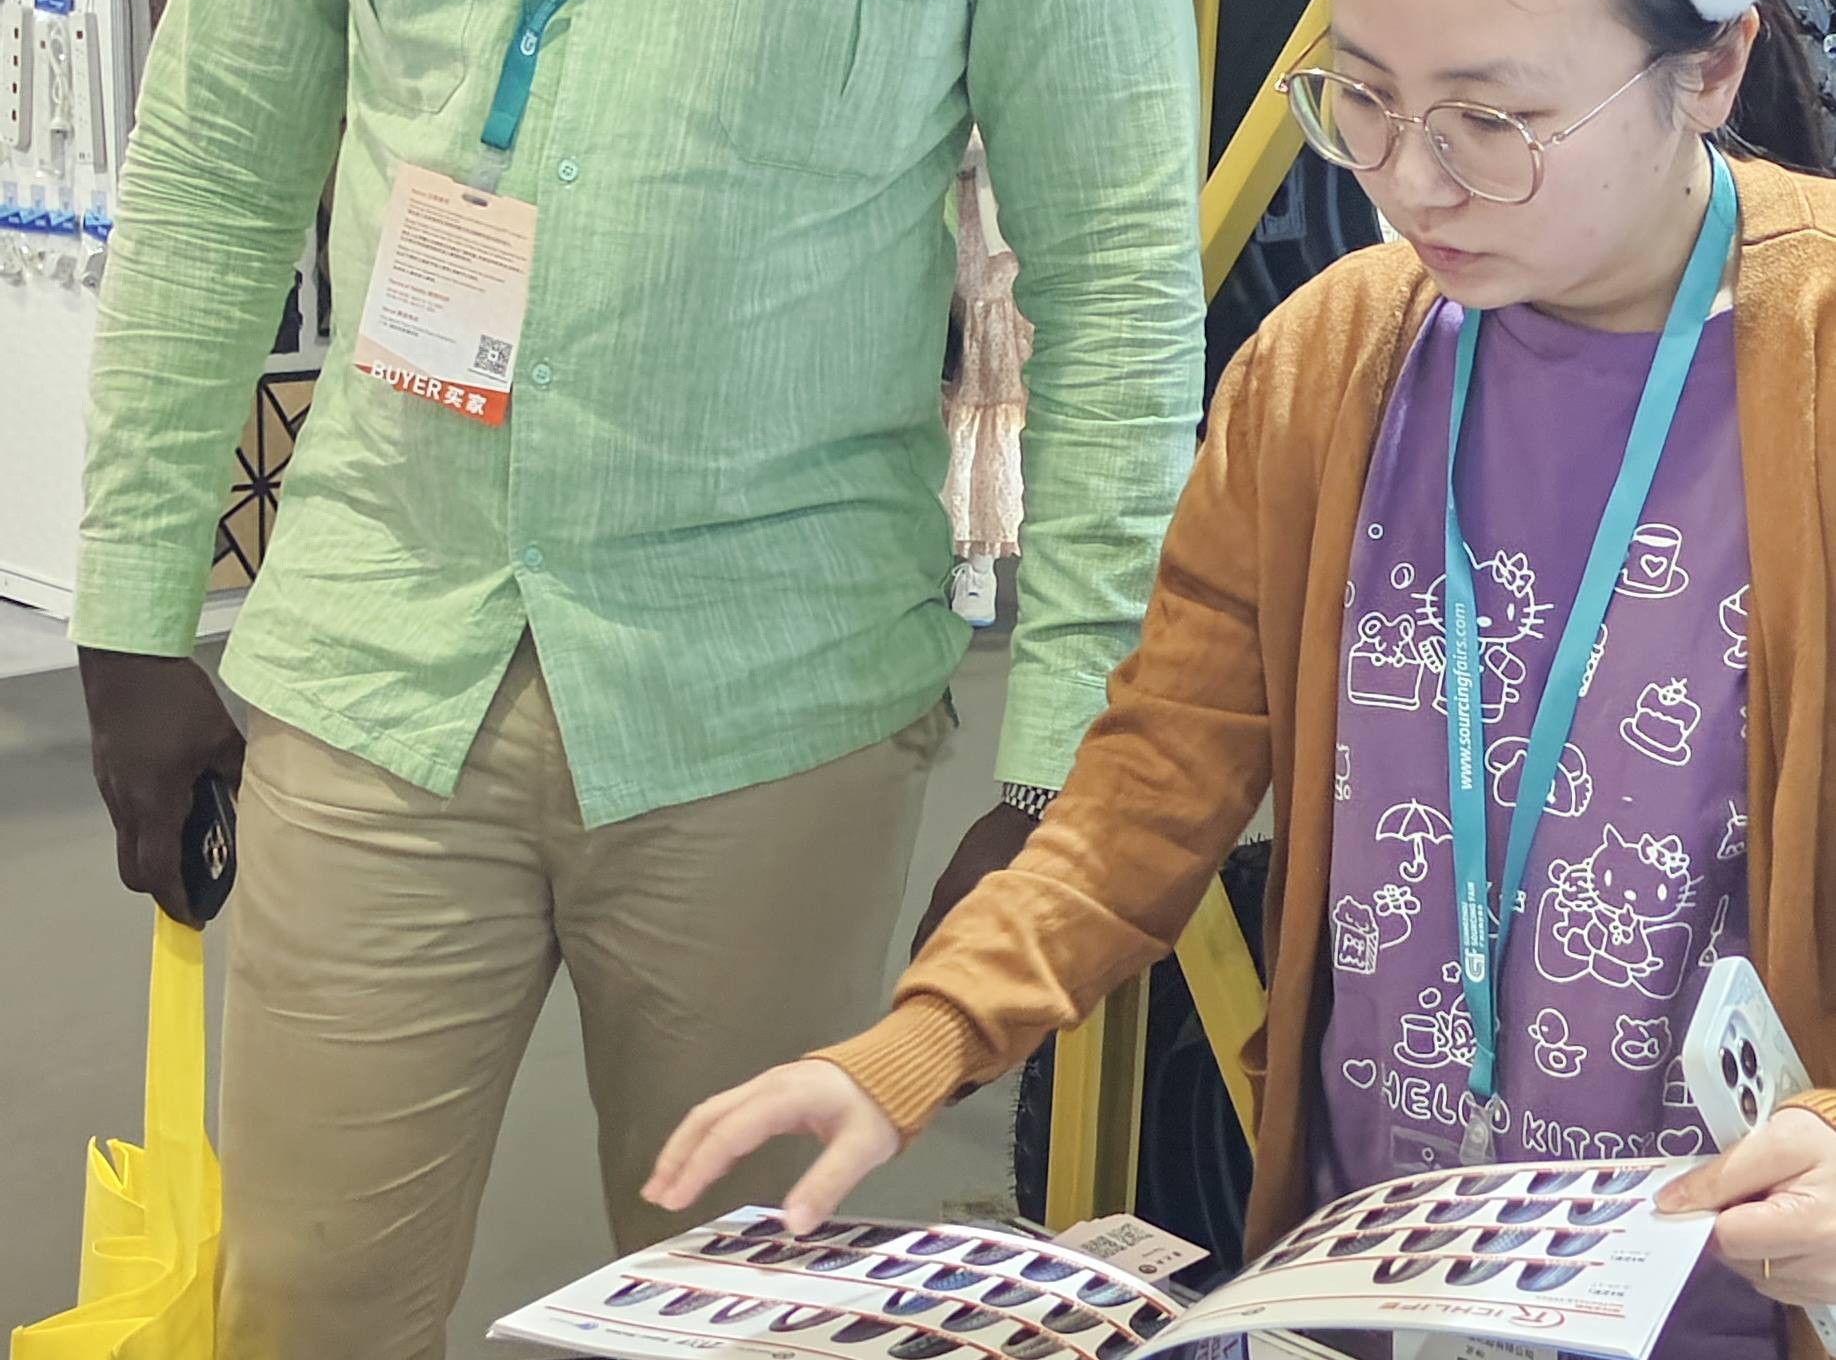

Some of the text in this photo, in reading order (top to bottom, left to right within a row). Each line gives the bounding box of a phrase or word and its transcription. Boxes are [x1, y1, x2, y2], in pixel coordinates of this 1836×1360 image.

[370, 360, 443, 401] BUYER
[443, 385, 488, 416] 买家
[1452, 602, 1474, 791] www.sourcingfairs.com
[1523, 1110, 1655, 1161] KITTY
